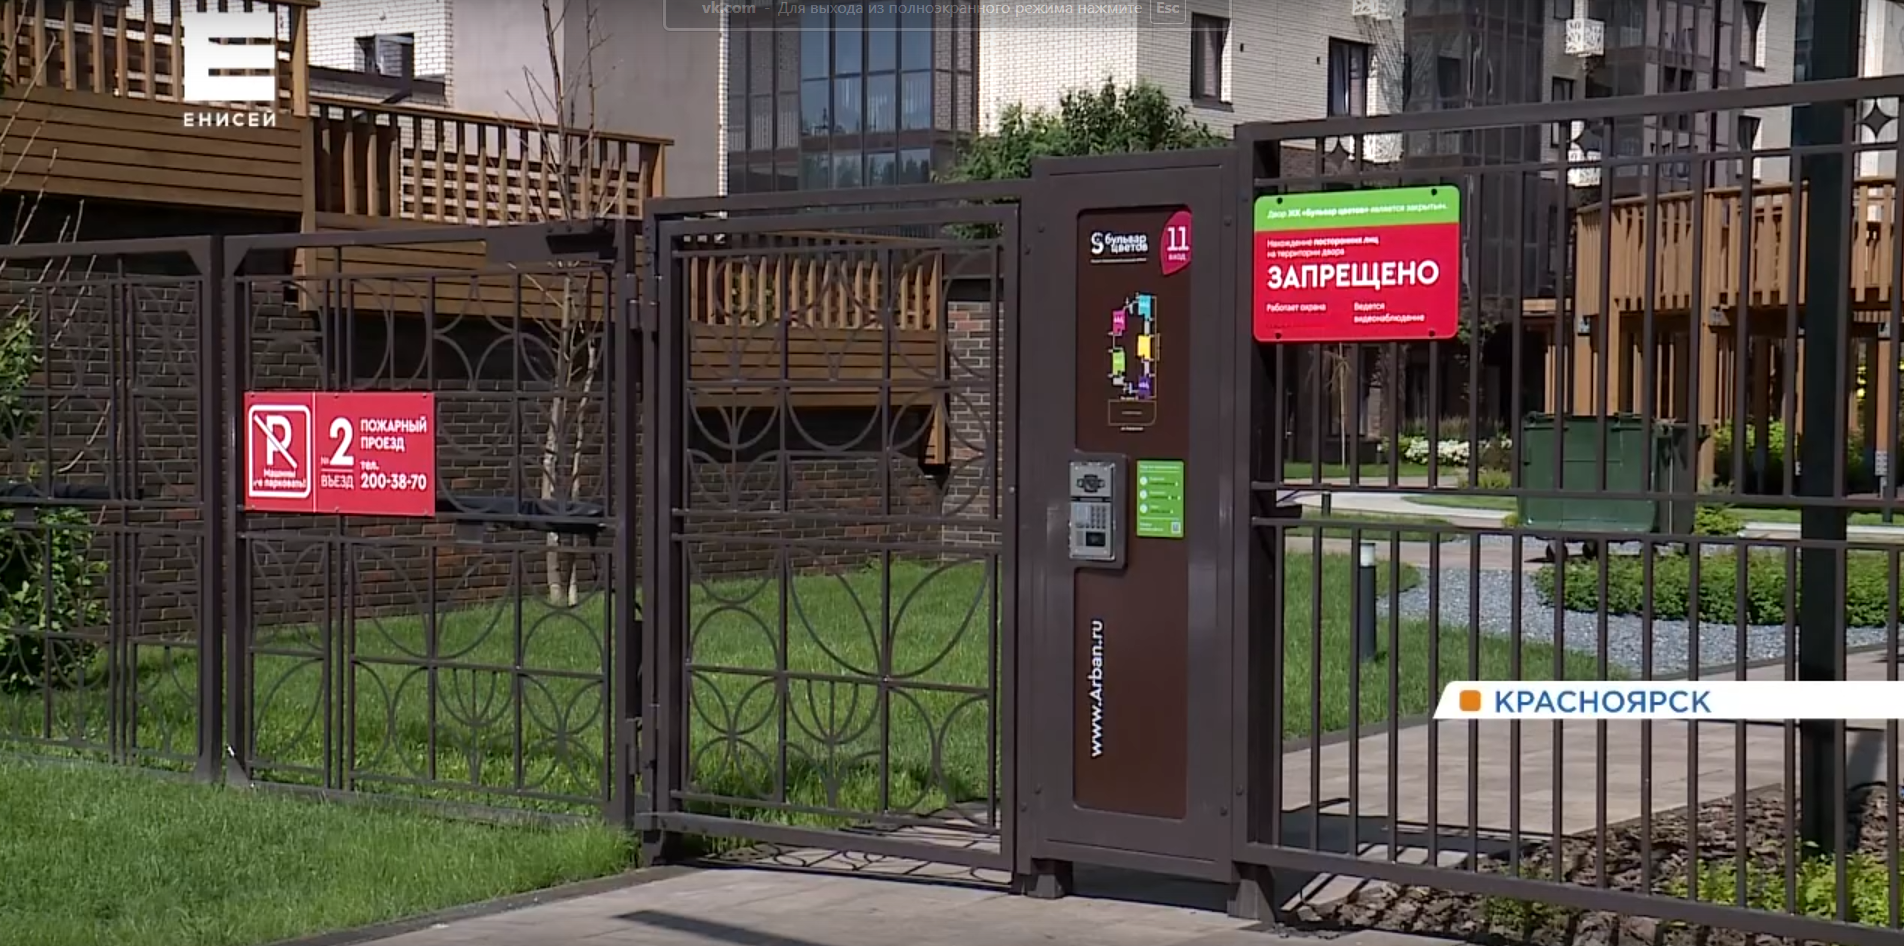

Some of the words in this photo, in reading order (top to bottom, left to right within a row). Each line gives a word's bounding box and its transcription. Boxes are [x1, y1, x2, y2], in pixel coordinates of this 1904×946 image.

[1267, 209, 1287, 219] Двор
[1288, 208, 1301, 217] ЖК
[1370, 204, 1405, 213] является
[1104, 232, 1147, 246] бульвар
[1166, 226, 1191, 252] 11
[1267, 238, 1312, 248] Нахождение
[1313, 237, 1362, 248] посторонних
[1363, 236, 1380, 246] лиц
[1111, 242, 1149, 254] цветов
[1267, 251, 1276, 259] на
[1277, 249, 1321, 259] территории
[1321, 248, 1345, 259] двора
[1267, 260, 1440, 291] ЗАПРЕЩЕНО
[1266, 302, 1299, 313] Работает
[1300, 302, 1327, 313] охрана
[1353, 301, 1386, 313] Ведется
[1353, 313, 1426, 324] видеонаблюдение
[360, 416, 428, 433] ПОЖАРНЫЙ
[329, 417, 354, 466] 2
[360, 436, 405, 452] ПРОЕЗД
[360, 460, 379, 471] тел.
[320, 474, 354, 489] ВЪЕЗД
[360, 473, 427, 490] 200-38-70
[1086, 620, 1105, 758] www.Arban.ru
